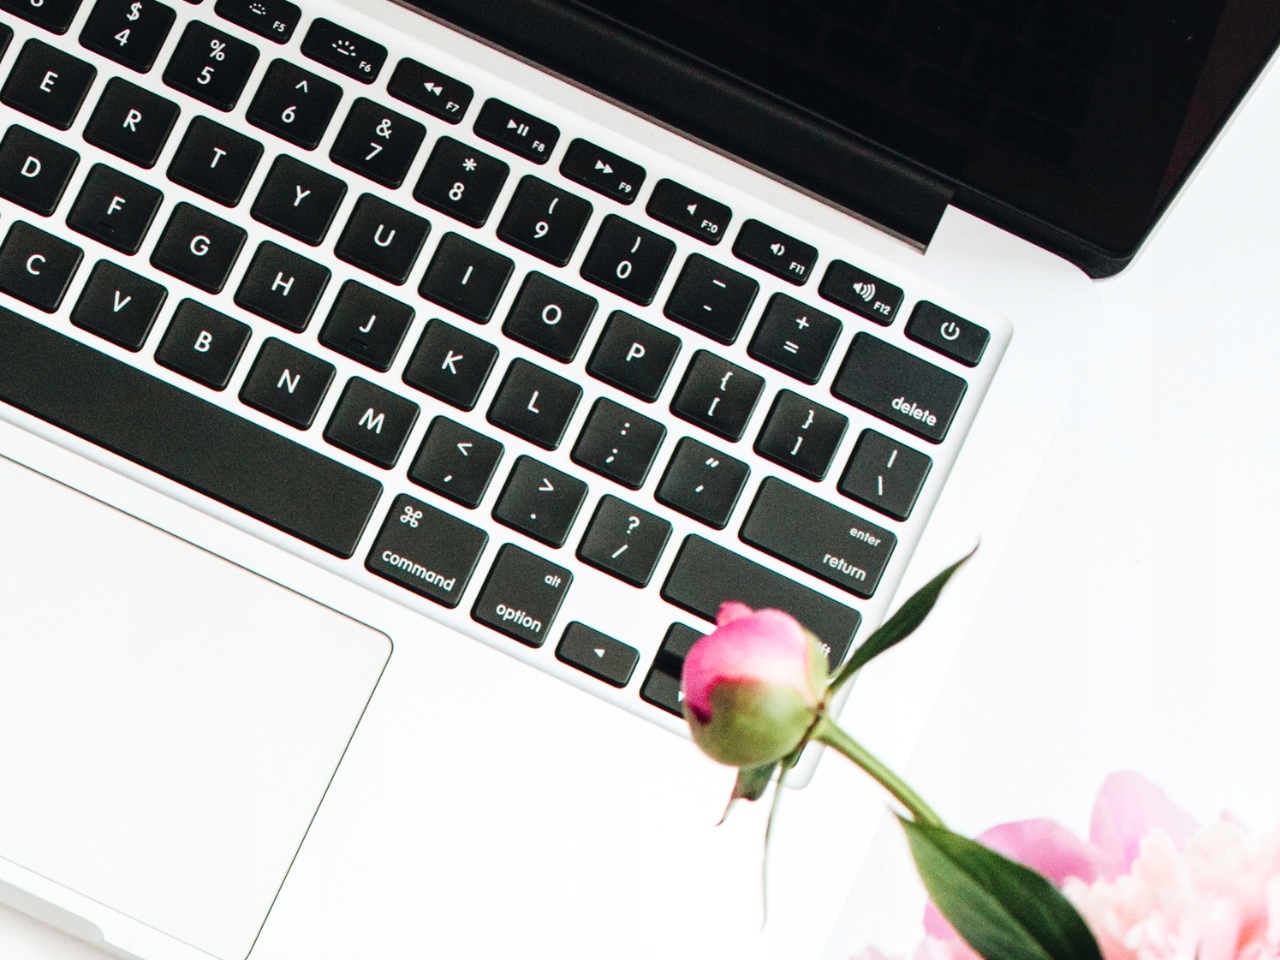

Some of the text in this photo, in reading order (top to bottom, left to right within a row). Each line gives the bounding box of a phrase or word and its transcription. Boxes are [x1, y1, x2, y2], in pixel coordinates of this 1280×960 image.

[127, 2, 142, 21] $
[273, 21, 285, 32] F5
[115, 29, 130, 46] 4
[210, 40, 225, 60] %
[197, 67, 214, 84] 5
[359, 61, 371, 72] F6
[40, 71, 58, 92] E
[282, 106, 296, 123] 6
[446, 102, 459, 112] F7
[123, 109, 141, 131] R
[376, 119, 392, 139] &
[366, 143, 382, 160] 7
[532, 141, 545, 152] F8
[21, 156, 41, 177] D
[211, 148, 226, 168] T
[294, 186, 310, 206] Y
[449, 183, 464, 200] 8
[619, 182, 631, 192] F9
[107, 196, 125, 214] F
[549, 198, 558, 214] (
[374, 225, 395, 246] U
[534, 222, 548, 238] 9
[190, 236, 210, 255] G
[631, 237, 641, 253] )
[27, 255, 45, 275] C
[790, 262, 805, 274] F11
[272, 272, 294, 296] H
[114, 291, 131, 312] V
[874, 302, 890, 315] F12
[359, 315, 376, 332] J
[542, 305, 561, 324] O
[796, 317, 809, 329] +
[194, 331, 212, 352] B
[784, 341, 798, 353] =
[626, 343, 645, 361] P
[442, 351, 463, 374] K
[277, 369, 300, 393] N
[721, 372, 733, 390] {
[528, 391, 539, 413] L
[708, 398, 720, 416] [
[359, 408, 384, 433] M
[802, 410, 814, 429] }
[891, 396, 937, 427] delete
[457, 443, 472, 455] <
[791, 437, 803, 455] ]
[539, 478, 553, 491] >
[627, 516, 640, 533] ?
[849, 525, 881, 547] enter
[612, 545, 628, 558] /
[381, 549, 456, 591] command
[823, 552, 867, 582] return
[545, 575, 561, 587] alt
[495, 603, 542, 633] option
